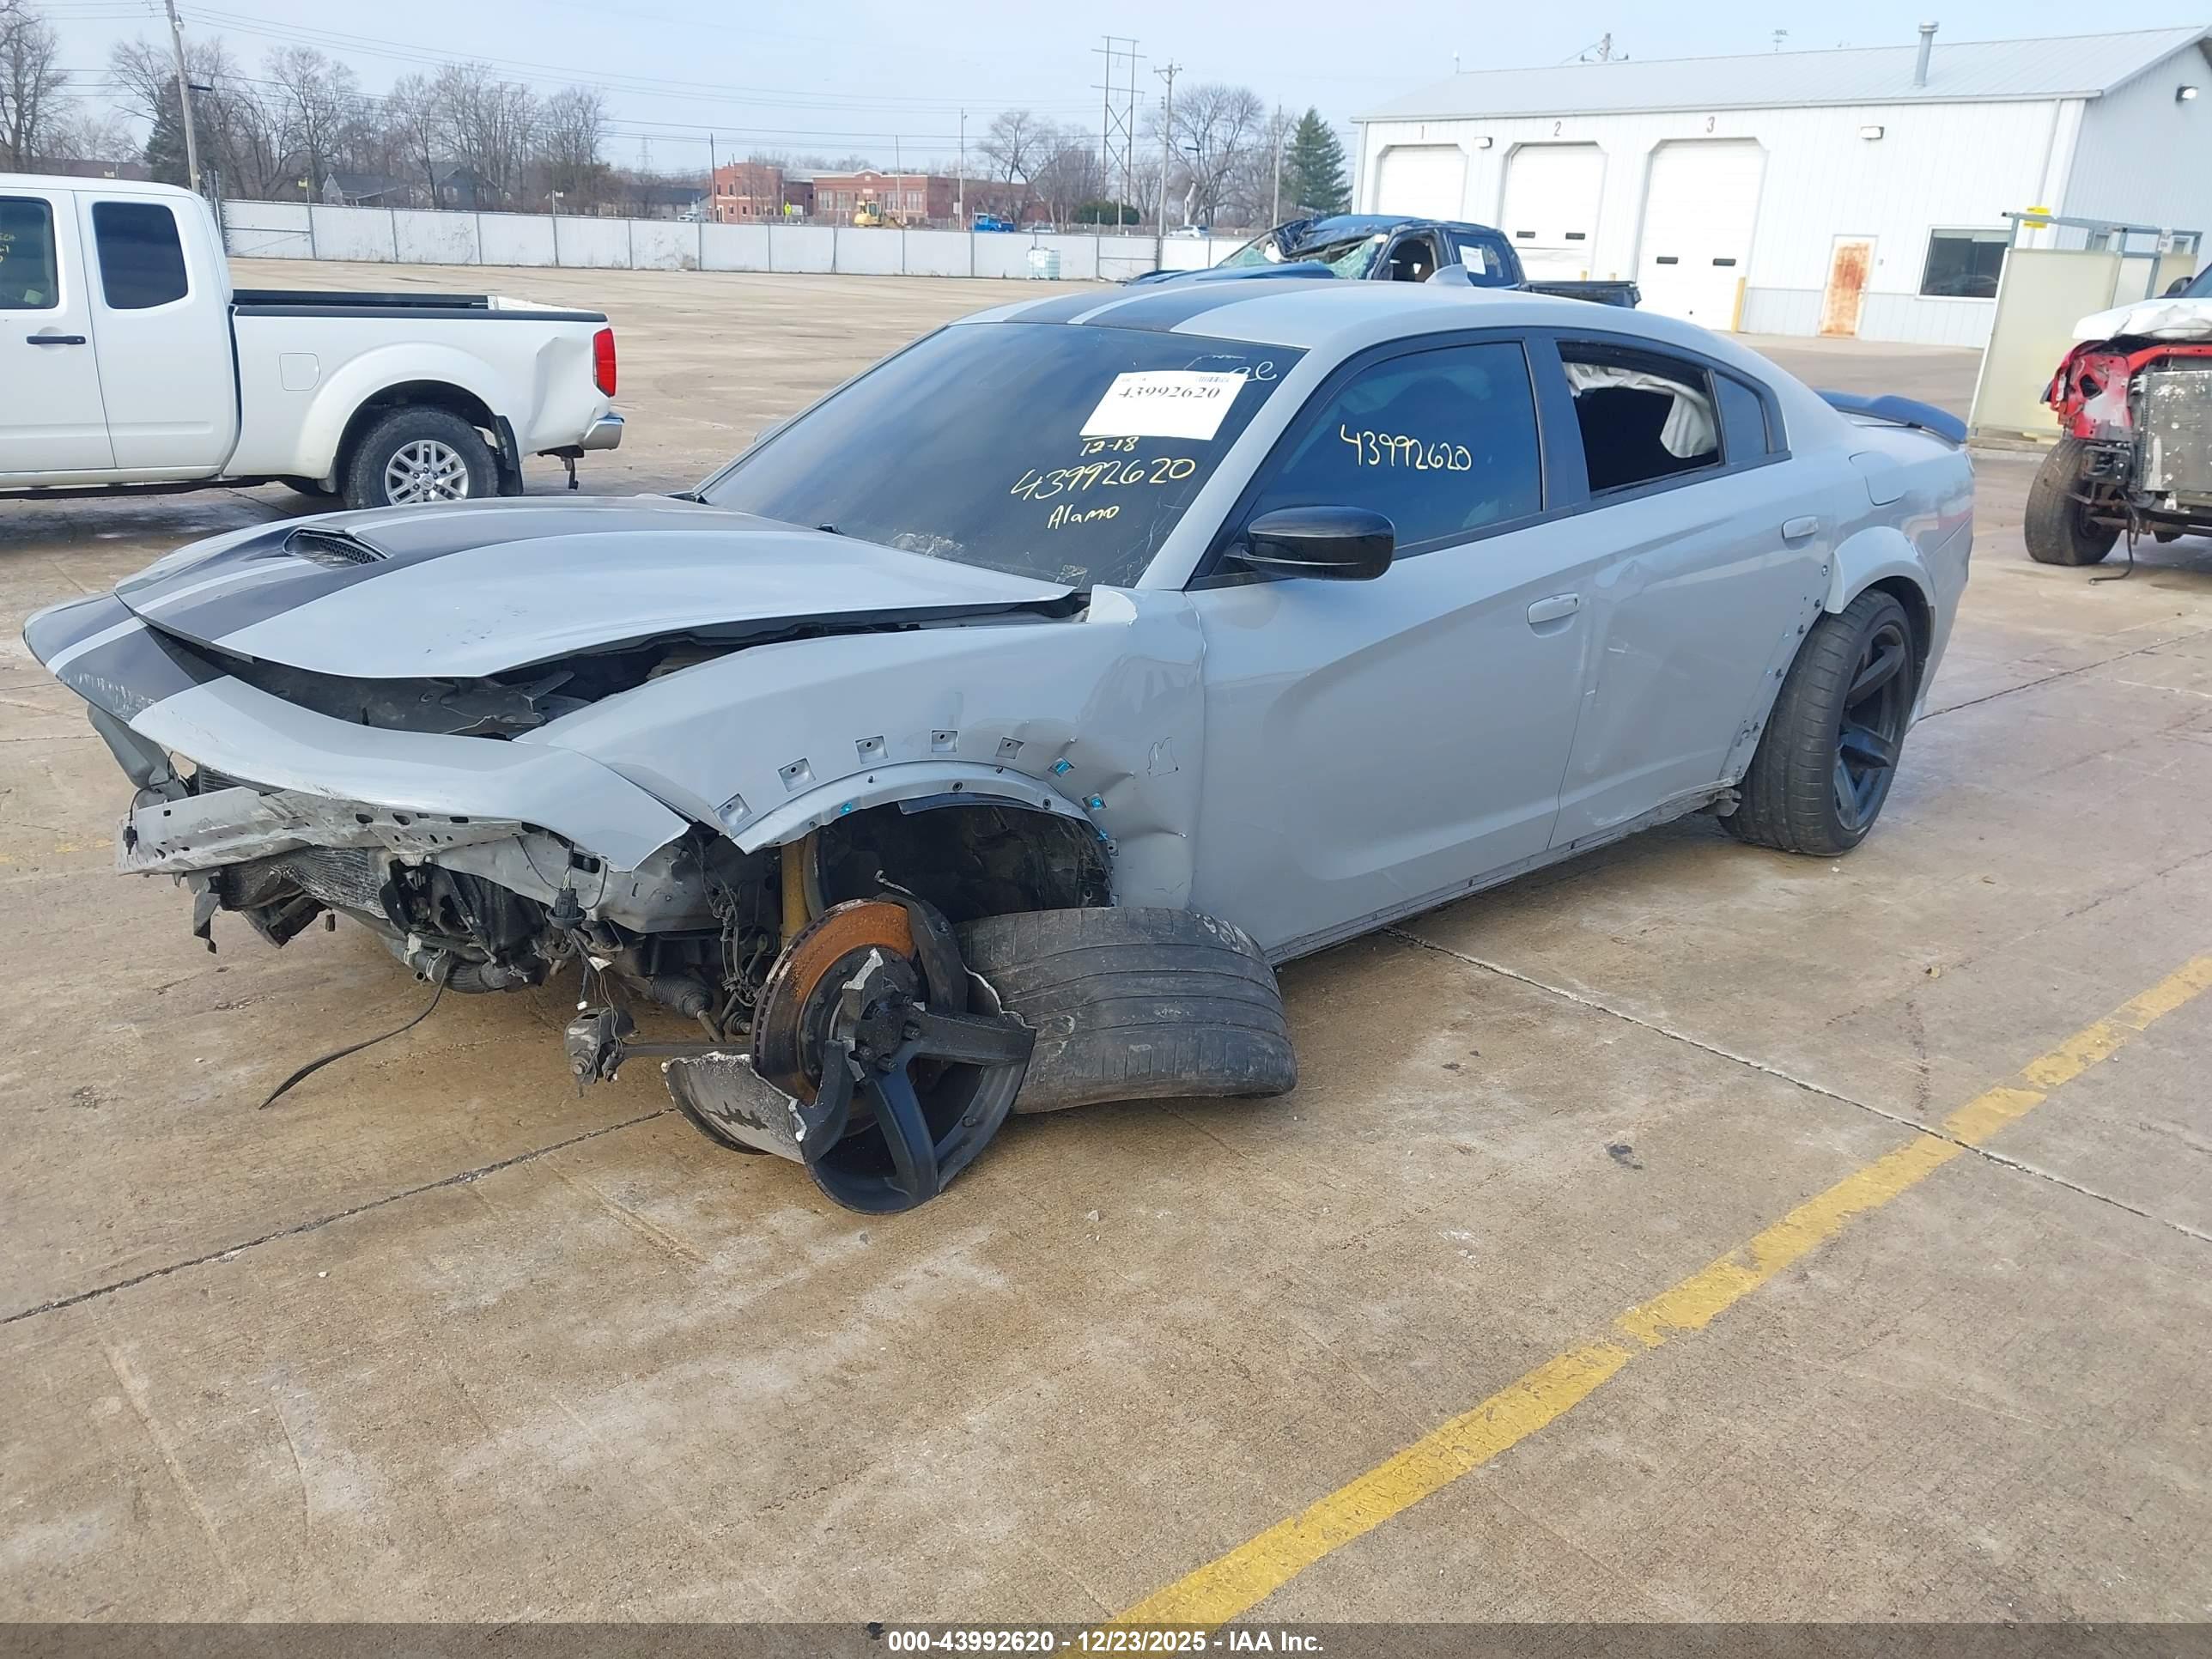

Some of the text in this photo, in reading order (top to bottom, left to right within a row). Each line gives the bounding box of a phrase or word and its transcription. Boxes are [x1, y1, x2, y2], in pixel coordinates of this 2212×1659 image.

[1420, 125, 1425, 140] 1
[1553, 121, 1562, 137] 2
[1706, 116, 1716, 133] 3
[1118, 386, 1221, 399] 43992620
[1079, 436, 1139, 457] 12-18
[1340, 423, 1472, 471] 43992620
[1010, 458, 1196, 501] 43992620
[1047, 504, 1121, 530] Alamo
